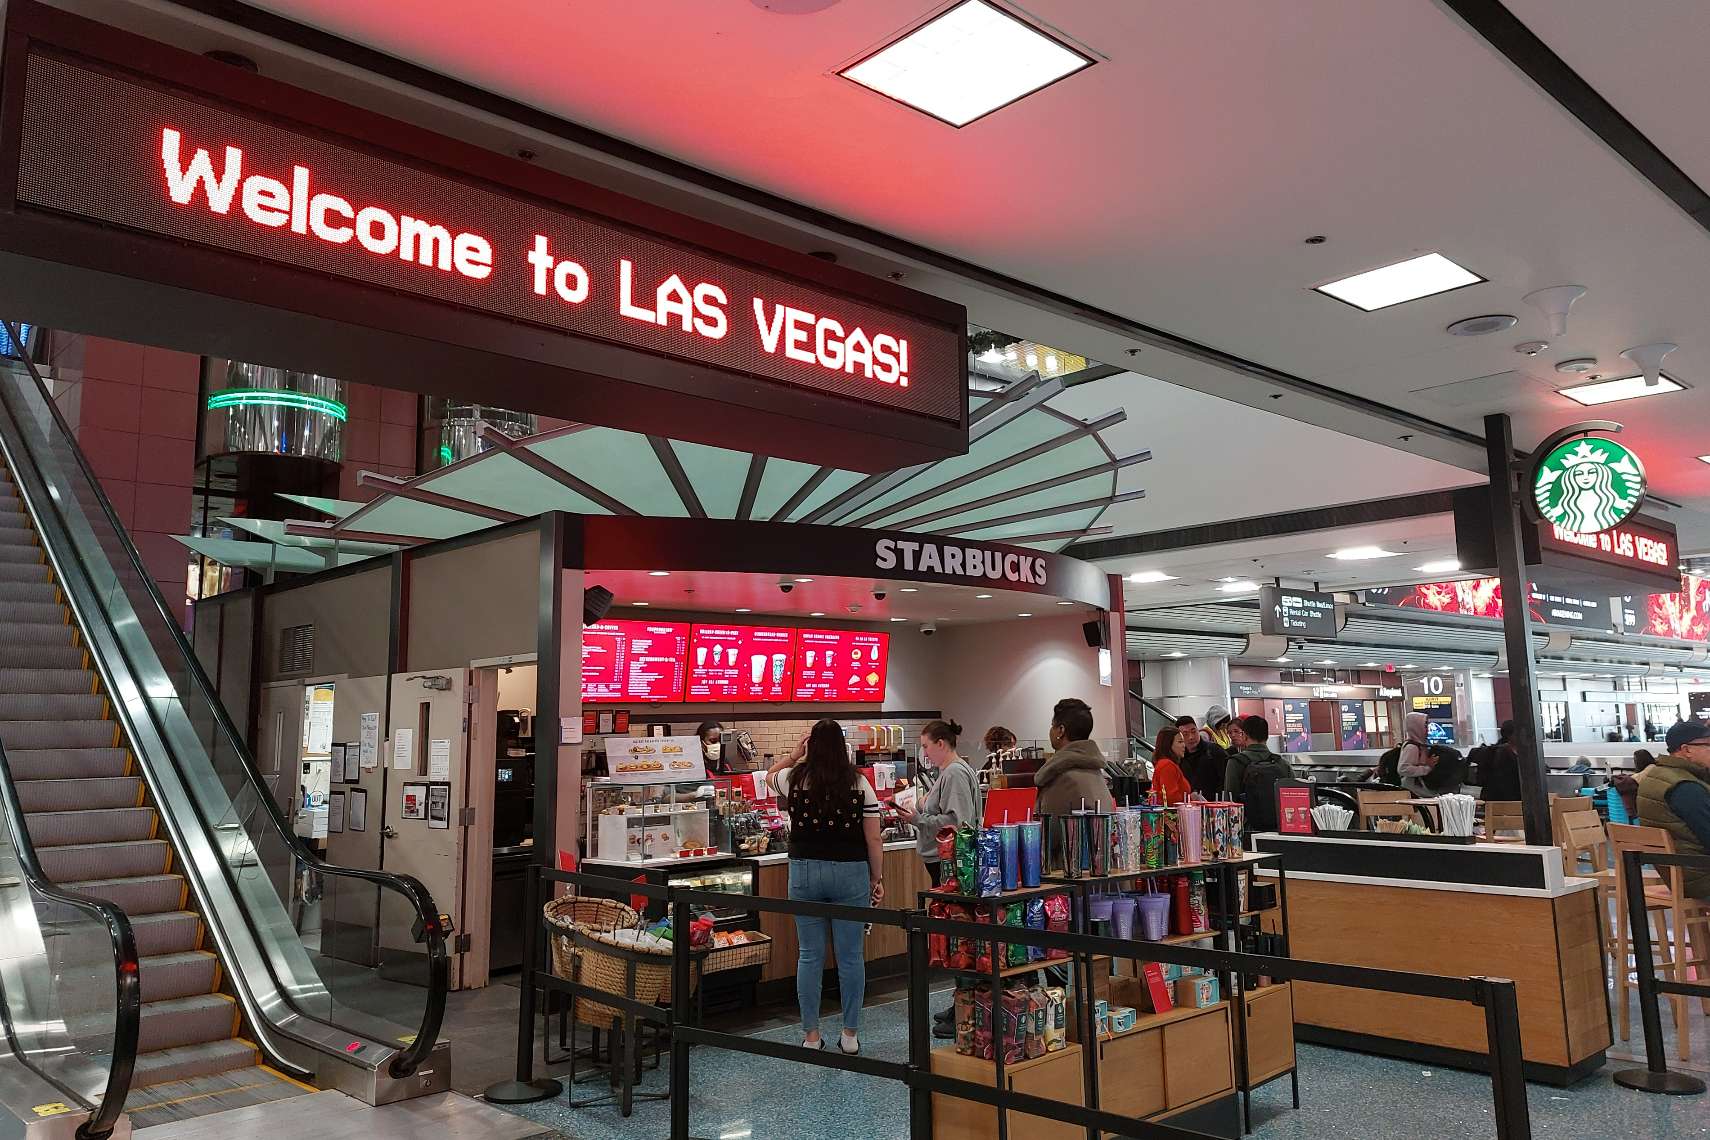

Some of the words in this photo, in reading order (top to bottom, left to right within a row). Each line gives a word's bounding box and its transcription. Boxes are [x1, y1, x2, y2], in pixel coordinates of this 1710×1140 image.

[161, 127, 493, 280] Welcome
[527, 234, 590, 304] to
[619, 259, 729, 340] LAS
[753, 297, 909, 387] VEGAS!
[875, 538, 1047, 586] STARBUCKS
[1612, 530, 1635, 558] LAS
[1635, 535, 1669, 566] VEGAS!
[1420, 676, 1443, 695] 10
